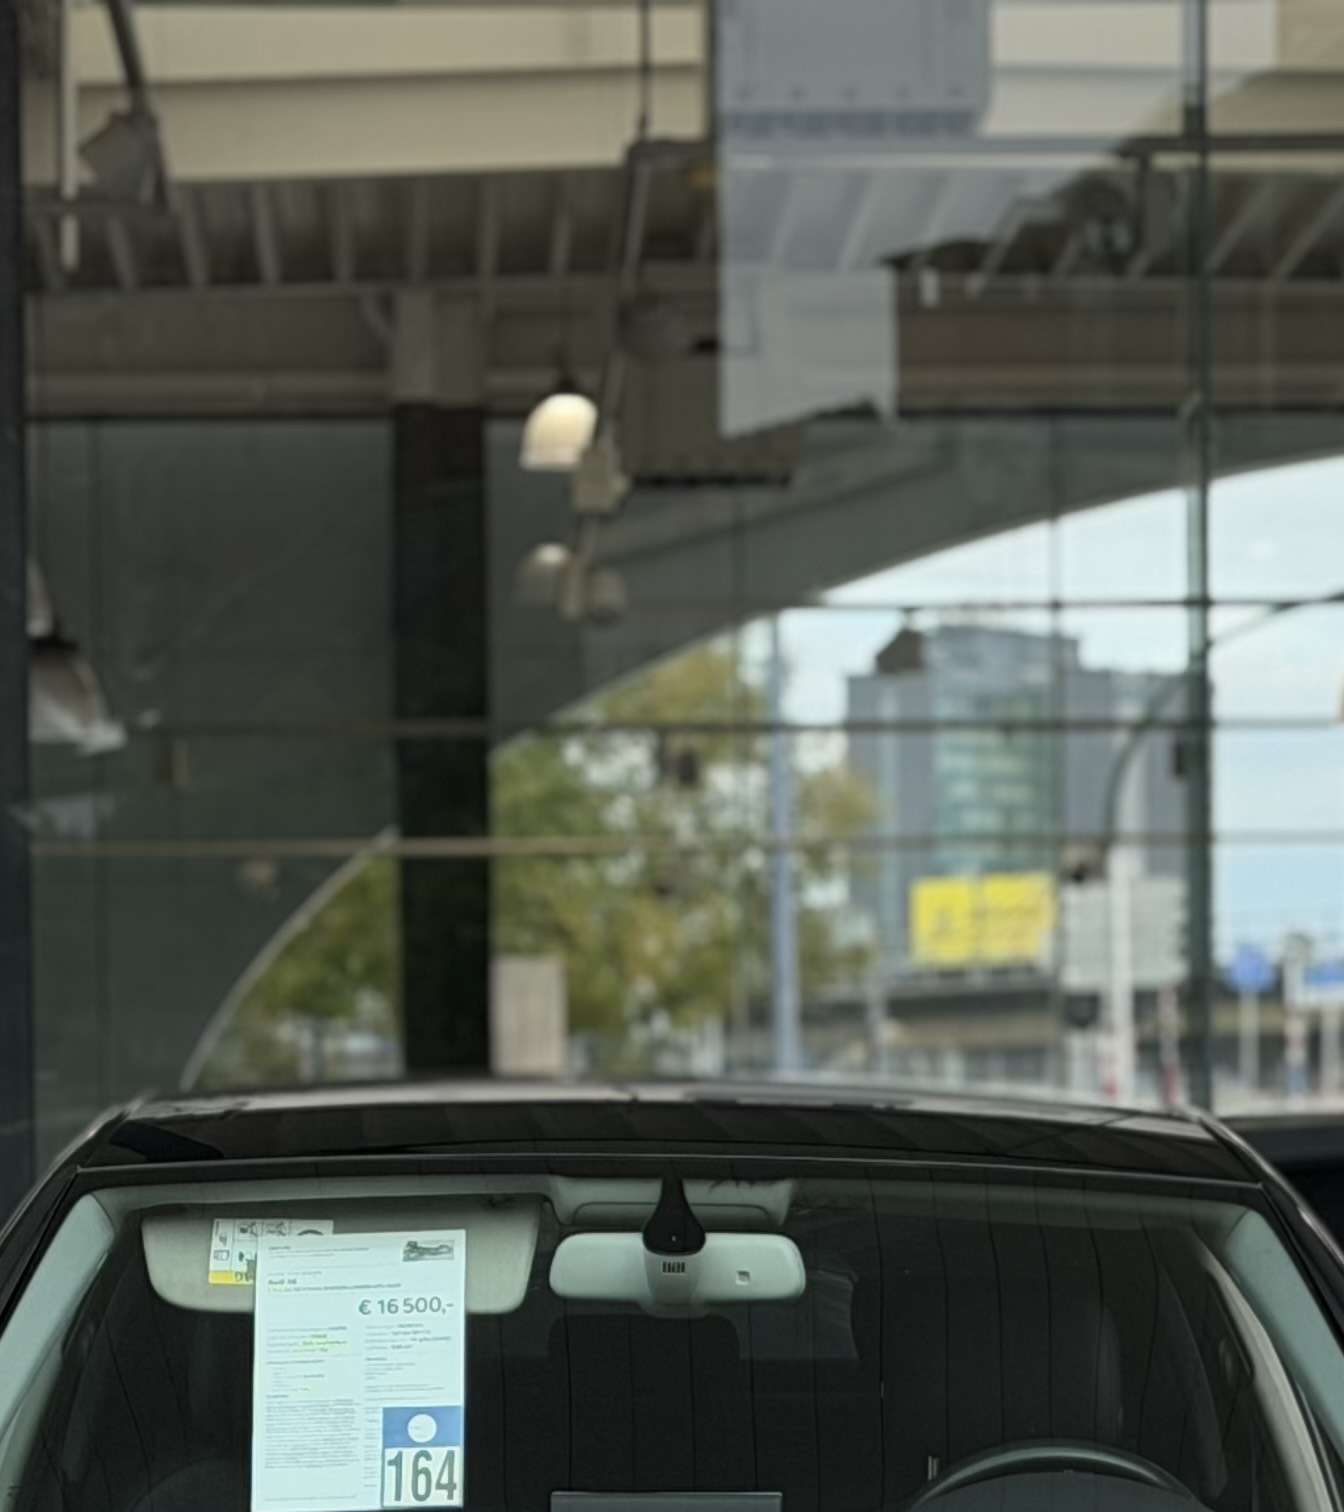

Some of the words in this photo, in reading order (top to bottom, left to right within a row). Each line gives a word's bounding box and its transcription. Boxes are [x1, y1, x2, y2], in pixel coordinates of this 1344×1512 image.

[358, 1299, 371, 1315] €
[377, 1299, 399, 1314] 16
[387, 1450, 457, 1502] 164
